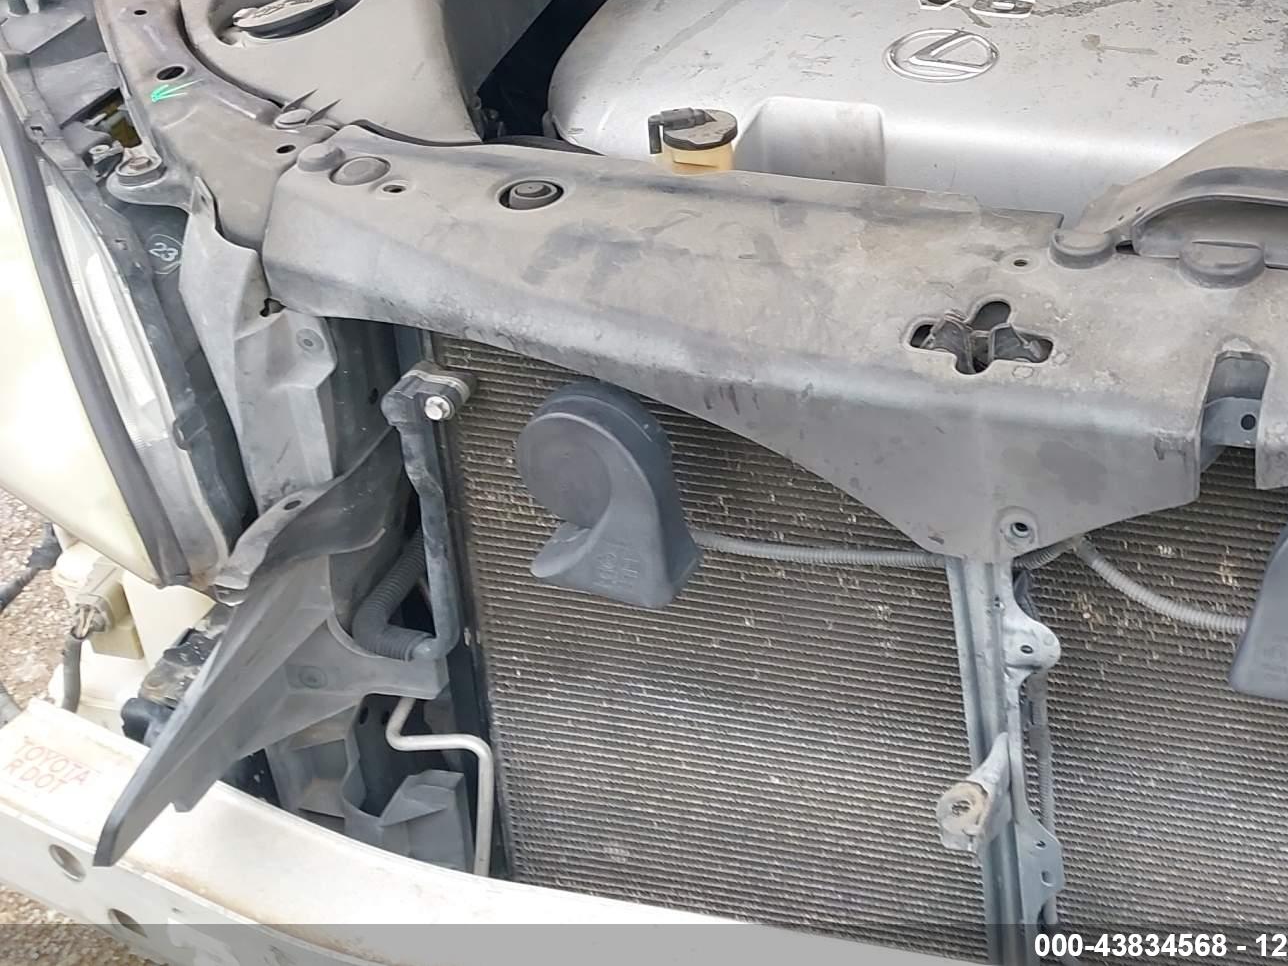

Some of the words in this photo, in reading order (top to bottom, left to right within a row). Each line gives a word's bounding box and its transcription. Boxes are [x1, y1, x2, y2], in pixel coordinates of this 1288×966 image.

[149, 242, 179, 262] 23
[2, 758, 24, 776] R
[19, 766, 68, 794] DOT
[14, 736, 91, 786] TOYOTA
